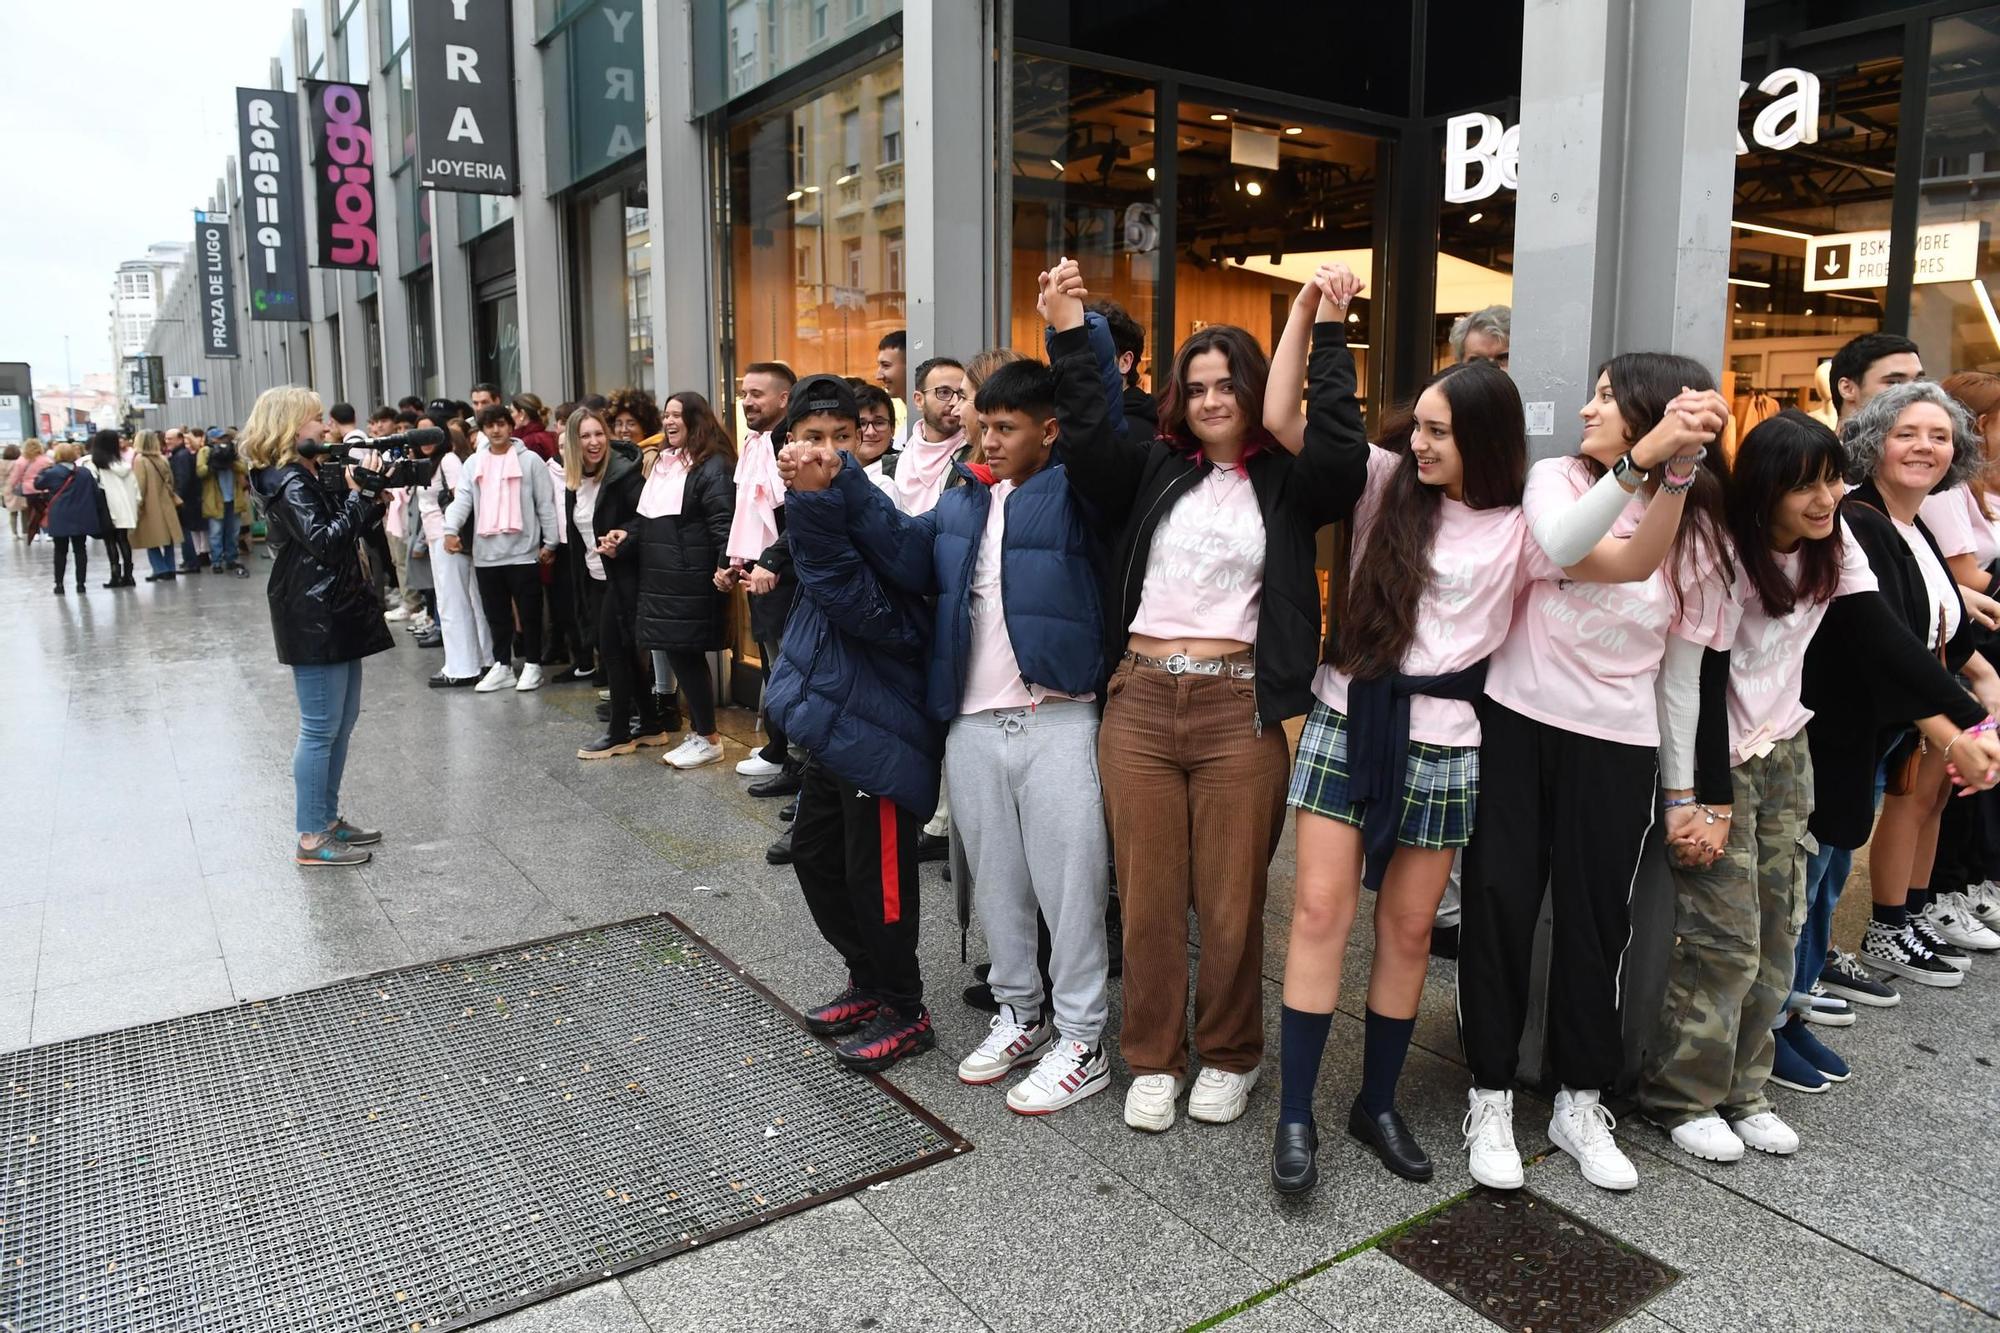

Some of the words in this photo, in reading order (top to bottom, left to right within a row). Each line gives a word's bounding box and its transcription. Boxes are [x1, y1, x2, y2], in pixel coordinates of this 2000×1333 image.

[323, 84, 378, 266] yoigo
[427, 158, 507, 181] JOYERIA
[205, 228, 222, 268] LUGO
[209, 271, 224, 296] DE
[210, 299, 228, 348] PRAZA
